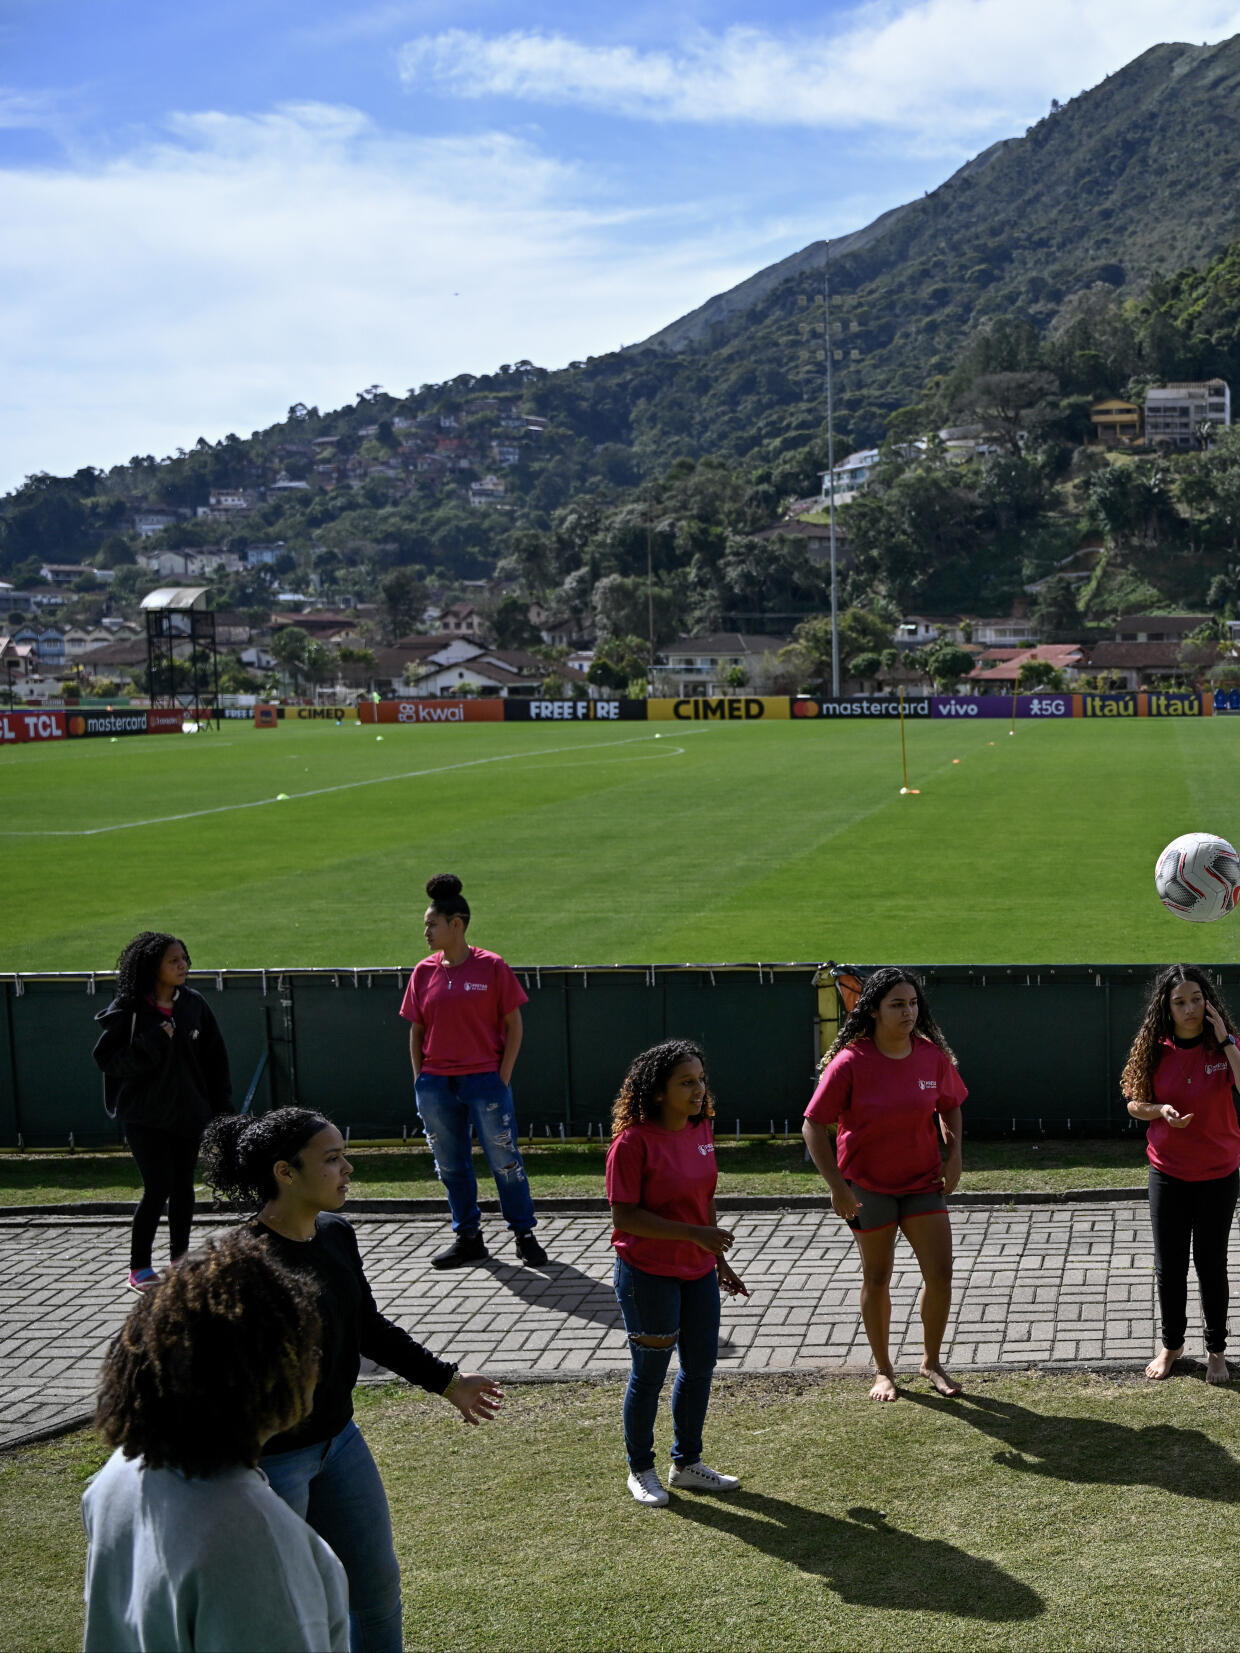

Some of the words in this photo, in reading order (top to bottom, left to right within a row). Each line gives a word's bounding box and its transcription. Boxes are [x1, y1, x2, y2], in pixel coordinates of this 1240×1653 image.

[297, 708, 345, 720] CIMED
[419, 704, 464, 722] kwai
[530, 701, 573, 719] FREE
[577, 701, 619, 719] FIRE
[673, 699, 765, 720] CIMED
[823, 700, 929, 716] mastercard
[939, 700, 978, 716] vivo
[1042, 700, 1065, 715] 5G
[1086, 696, 1134, 716] Itaú
[1151, 696, 1199, 716] Itaú
[0, 718, 16, 739] L
[24, 716, 62, 738] TCL
[88, 713, 147, 733] mastercard
